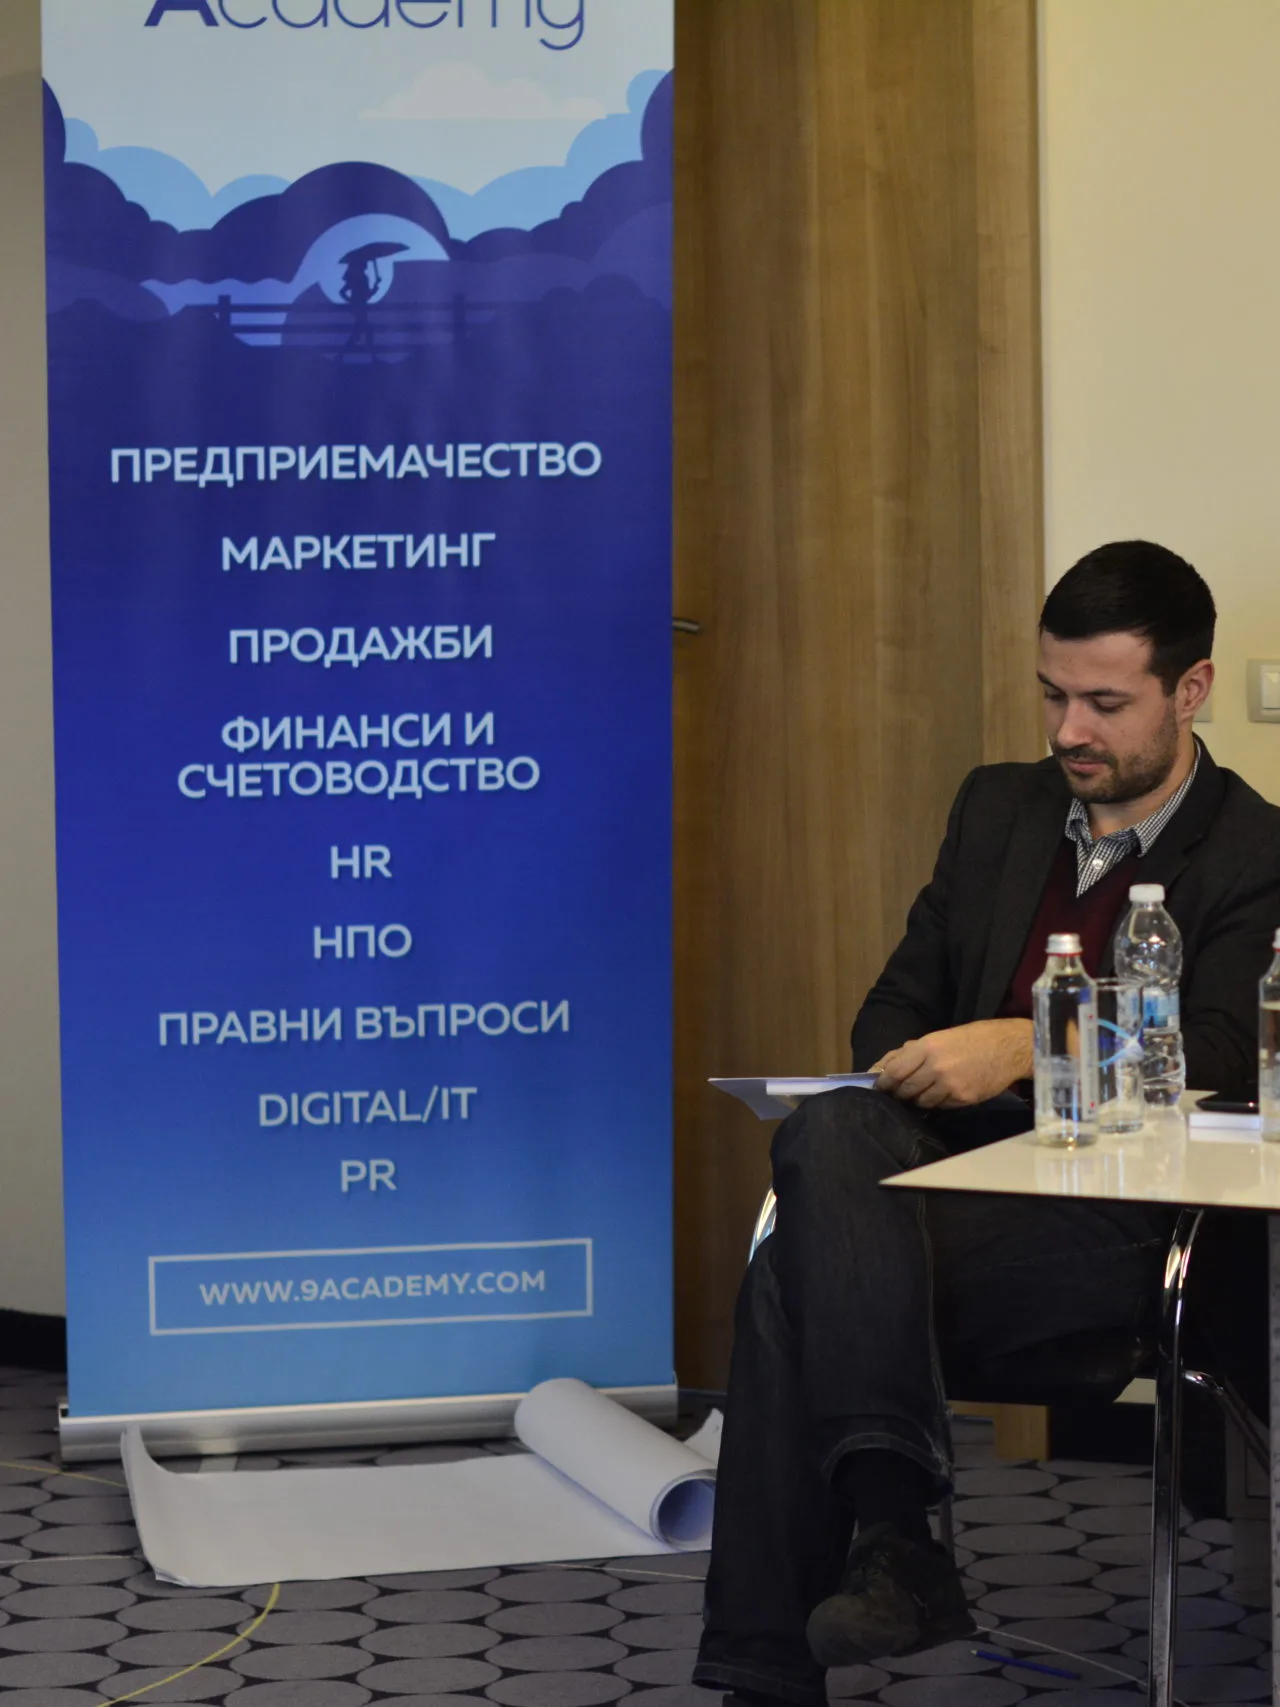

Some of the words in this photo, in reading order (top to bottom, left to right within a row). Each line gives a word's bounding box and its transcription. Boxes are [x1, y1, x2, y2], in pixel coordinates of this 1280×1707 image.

[111, 441, 602, 488] ПРЕДПРИЕМАЧЕСТВО
[222, 532, 496, 571] МАРКЕТИНГ
[230, 624, 492, 668] ПРОДАЖБИ
[222, 713, 450, 753] ФИНАНСИ
[466, 712, 494, 746] И
[178, 756, 541, 800] СЧЕТОВОДСТВО
[331, 845, 392, 879] HR
[314, 923, 412, 959] НПО
[160, 1007, 342, 1046] ПРАВНИ
[356, 1000, 569, 1040] ВЪПРОСИ
[260, 1085, 478, 1127] DIGITAL/IT
[341, 1159, 397, 1193] PR
[200, 1270, 545, 1306] WWW.9ACADEMY.COM
